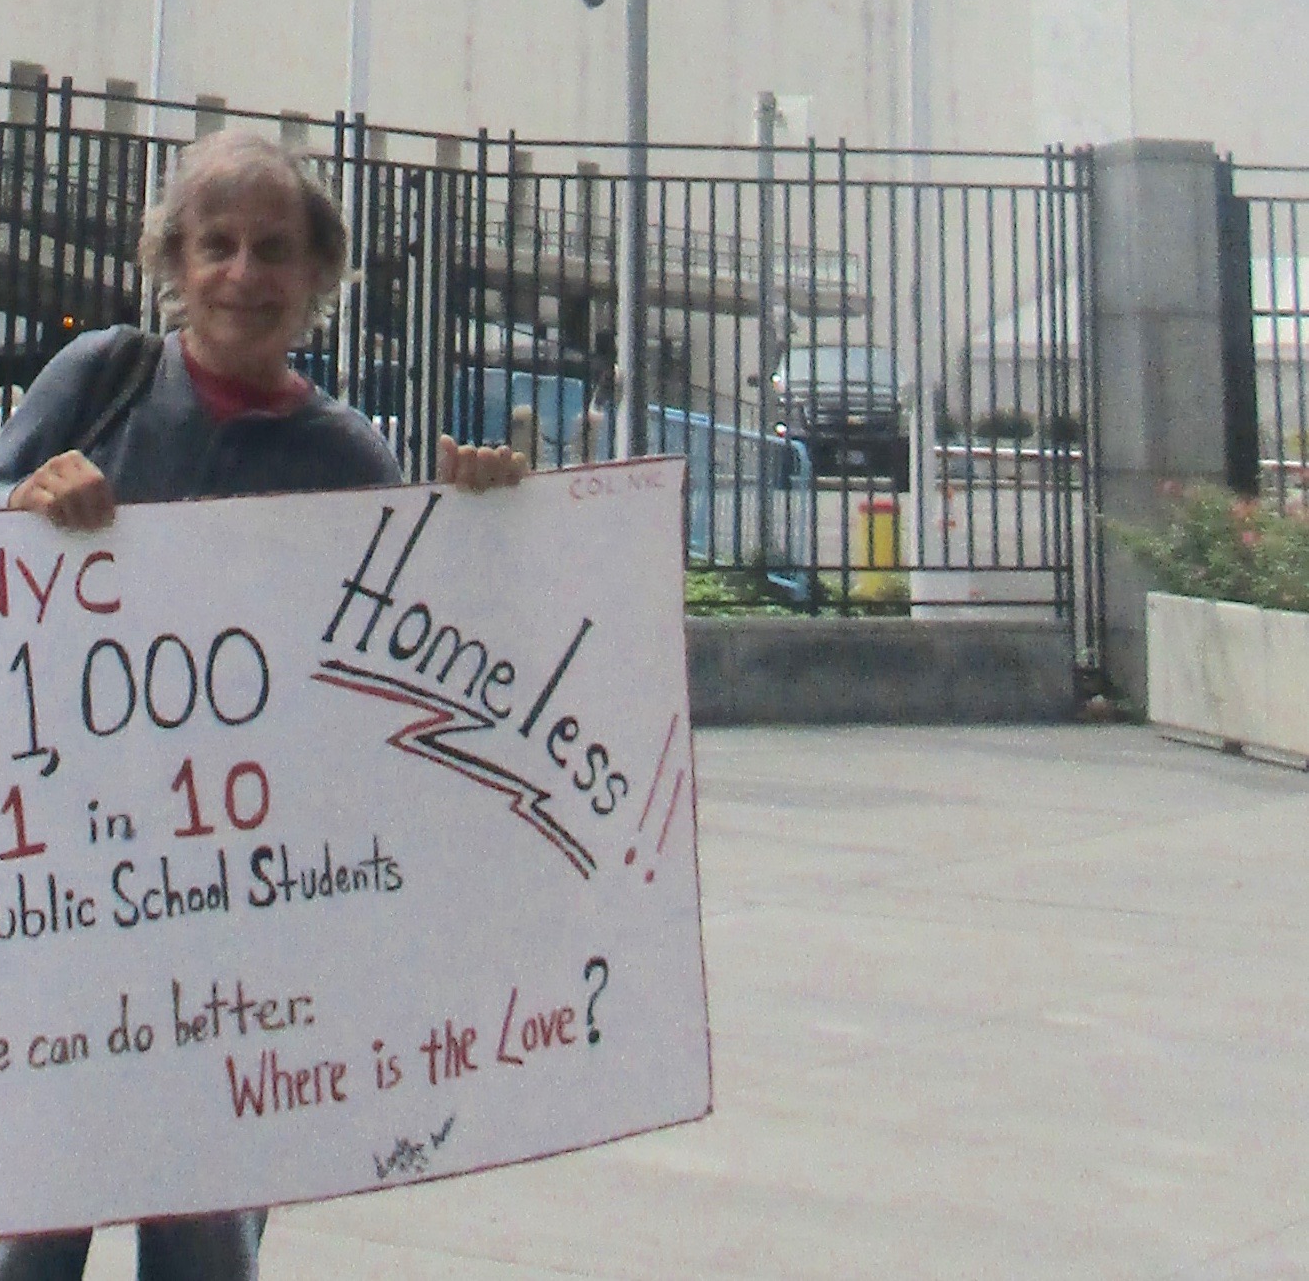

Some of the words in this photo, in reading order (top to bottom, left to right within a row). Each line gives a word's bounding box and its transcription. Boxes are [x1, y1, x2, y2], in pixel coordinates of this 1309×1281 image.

[0, 784, 48, 861] 1
[88, 799, 136, 844] in
[171, 755, 271, 838] 10
[111, 848, 230, 928] School
[247, 834, 404, 908] Students
[27, 1030, 90, 1070] can
[106, 993, 155, 1055] do
[225, 1048, 348, 1119] Where
[372, 1037, 403, 1090] is
[419, 1018, 479, 1087] the
